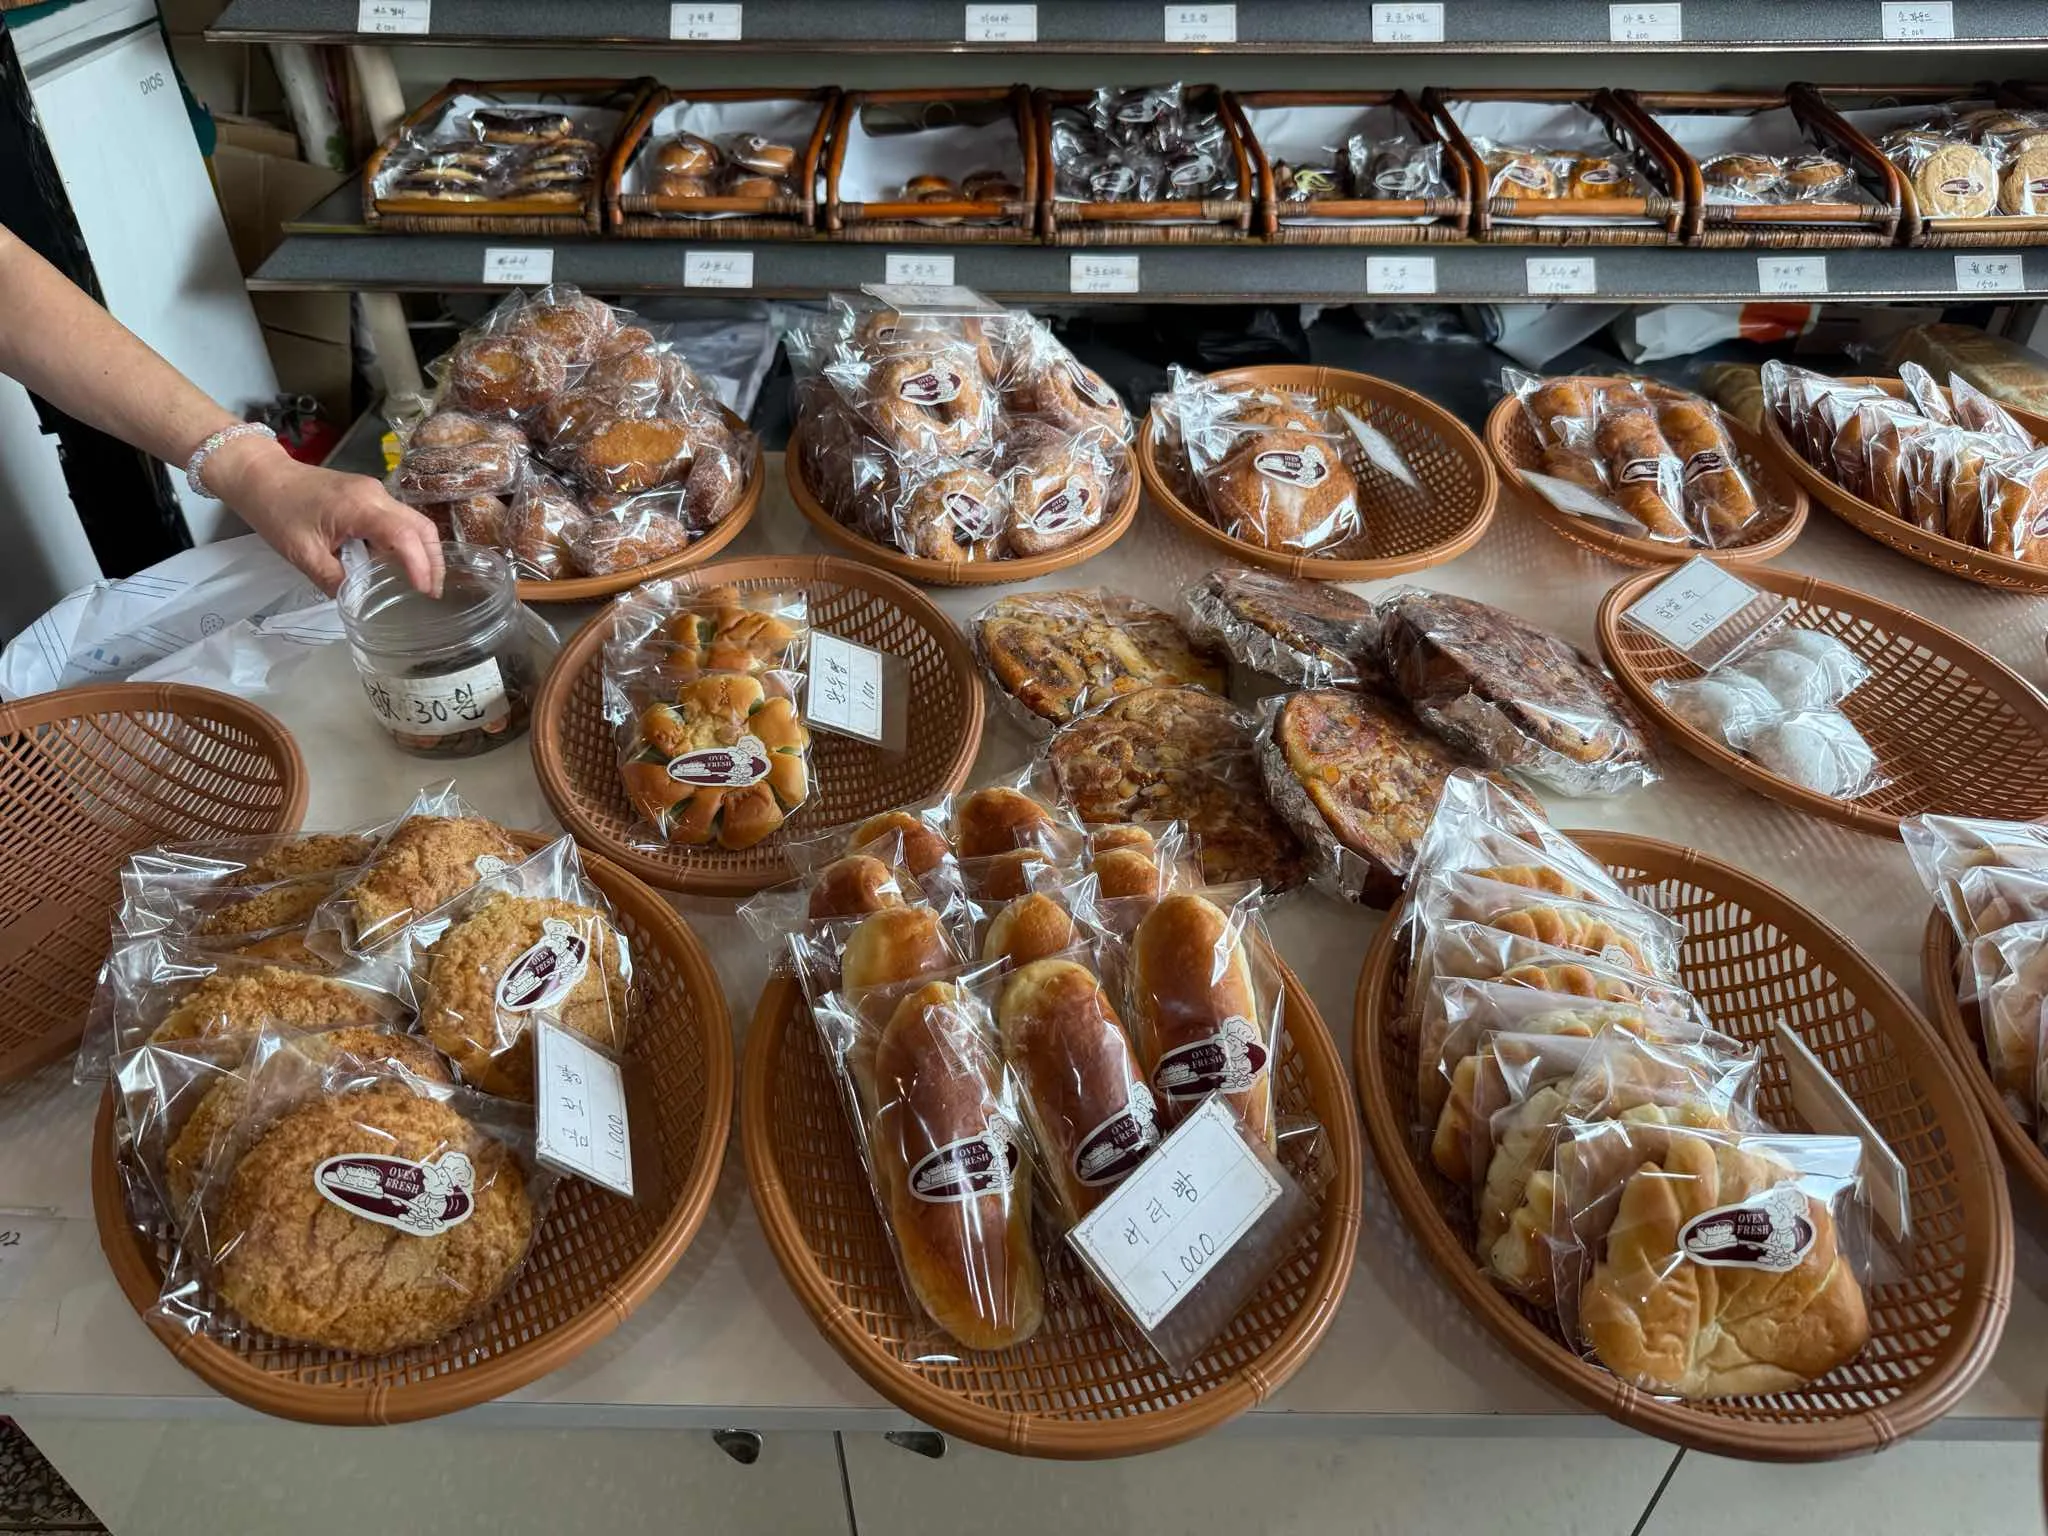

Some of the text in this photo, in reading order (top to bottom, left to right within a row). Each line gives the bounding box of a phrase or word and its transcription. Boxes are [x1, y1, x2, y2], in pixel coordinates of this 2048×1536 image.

[140, 72, 164, 95] DIOS
[531, 950, 550, 966] OVEN
[535, 956, 555, 975] FRESH
[1191, 1045, 1219, 1060] OVEN
[556, 1064, 589, 1148] 곰보빵
[389, 1166, 419, 1183] OVEN
[385, 1177, 420, 1195] FRESH
[1737, 1212, 1765, 1223] OVEN
[1736, 1223, 1770, 1236] FRESH
